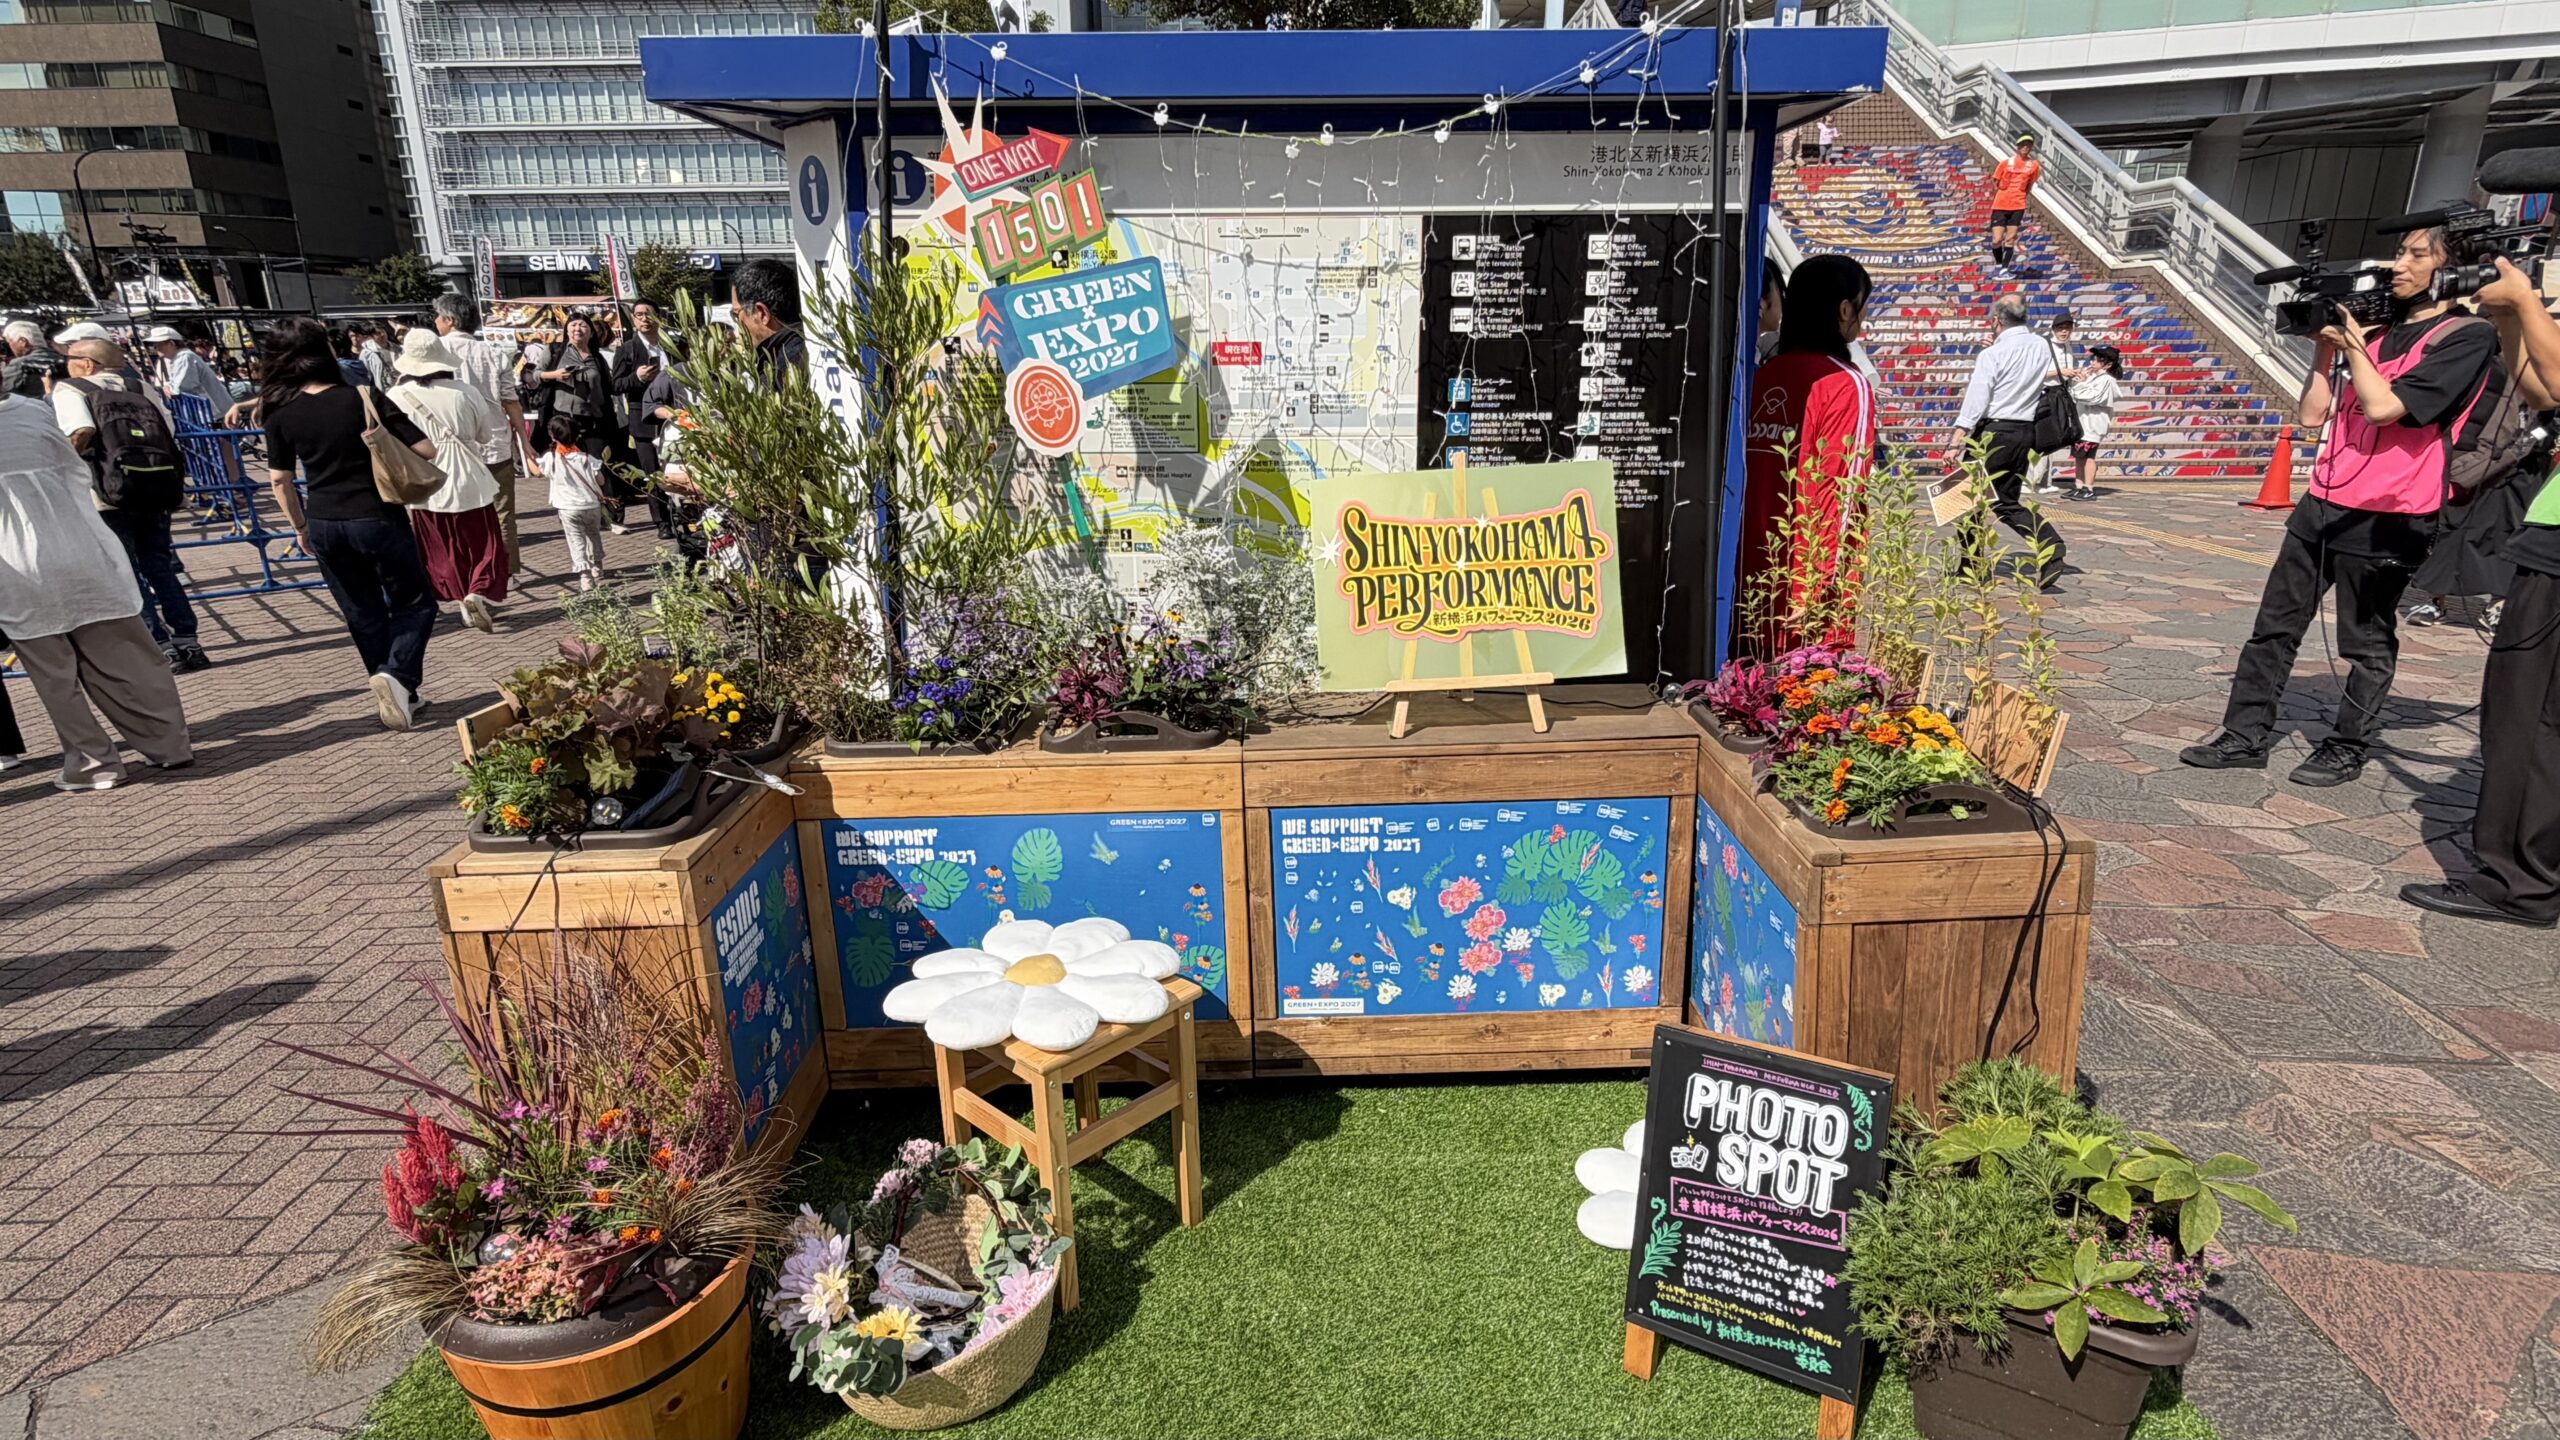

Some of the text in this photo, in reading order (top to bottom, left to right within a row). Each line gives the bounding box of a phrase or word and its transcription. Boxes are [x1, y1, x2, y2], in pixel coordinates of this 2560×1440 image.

[1590, 145, 1743, 163] 港北区新横浜2目
[987, 183, 1094, 256] 150!
[478, 239, 492, 297] TACOS
[1014, 269, 1152, 319] GREEN
[1028, 306, 1160, 360] EXPO
[1070, 341, 1139, 379] 2027
[1343, 495, 1606, 572] SHIN-YOKOHAMA
[1342, 563, 1596, 635] PERFORMANCE
[1433, 610, 1591, 632] 新横浜パフォーマンス2026
[835, 828, 938, 847] WE SUPPORT
[1282, 819, 1306, 835] WE
[1310, 817, 1383, 835] SUPPORT
[1383, 838, 1420, 854] 2027
[716, 880, 760, 956] SSMC
[1684, 1073, 1849, 1160] PHOTO
[1717, 1133, 1848, 1217] SPOT
[1650, 1299, 1700, 1326] Presented
[1700, 1315, 1712, 1335] by
